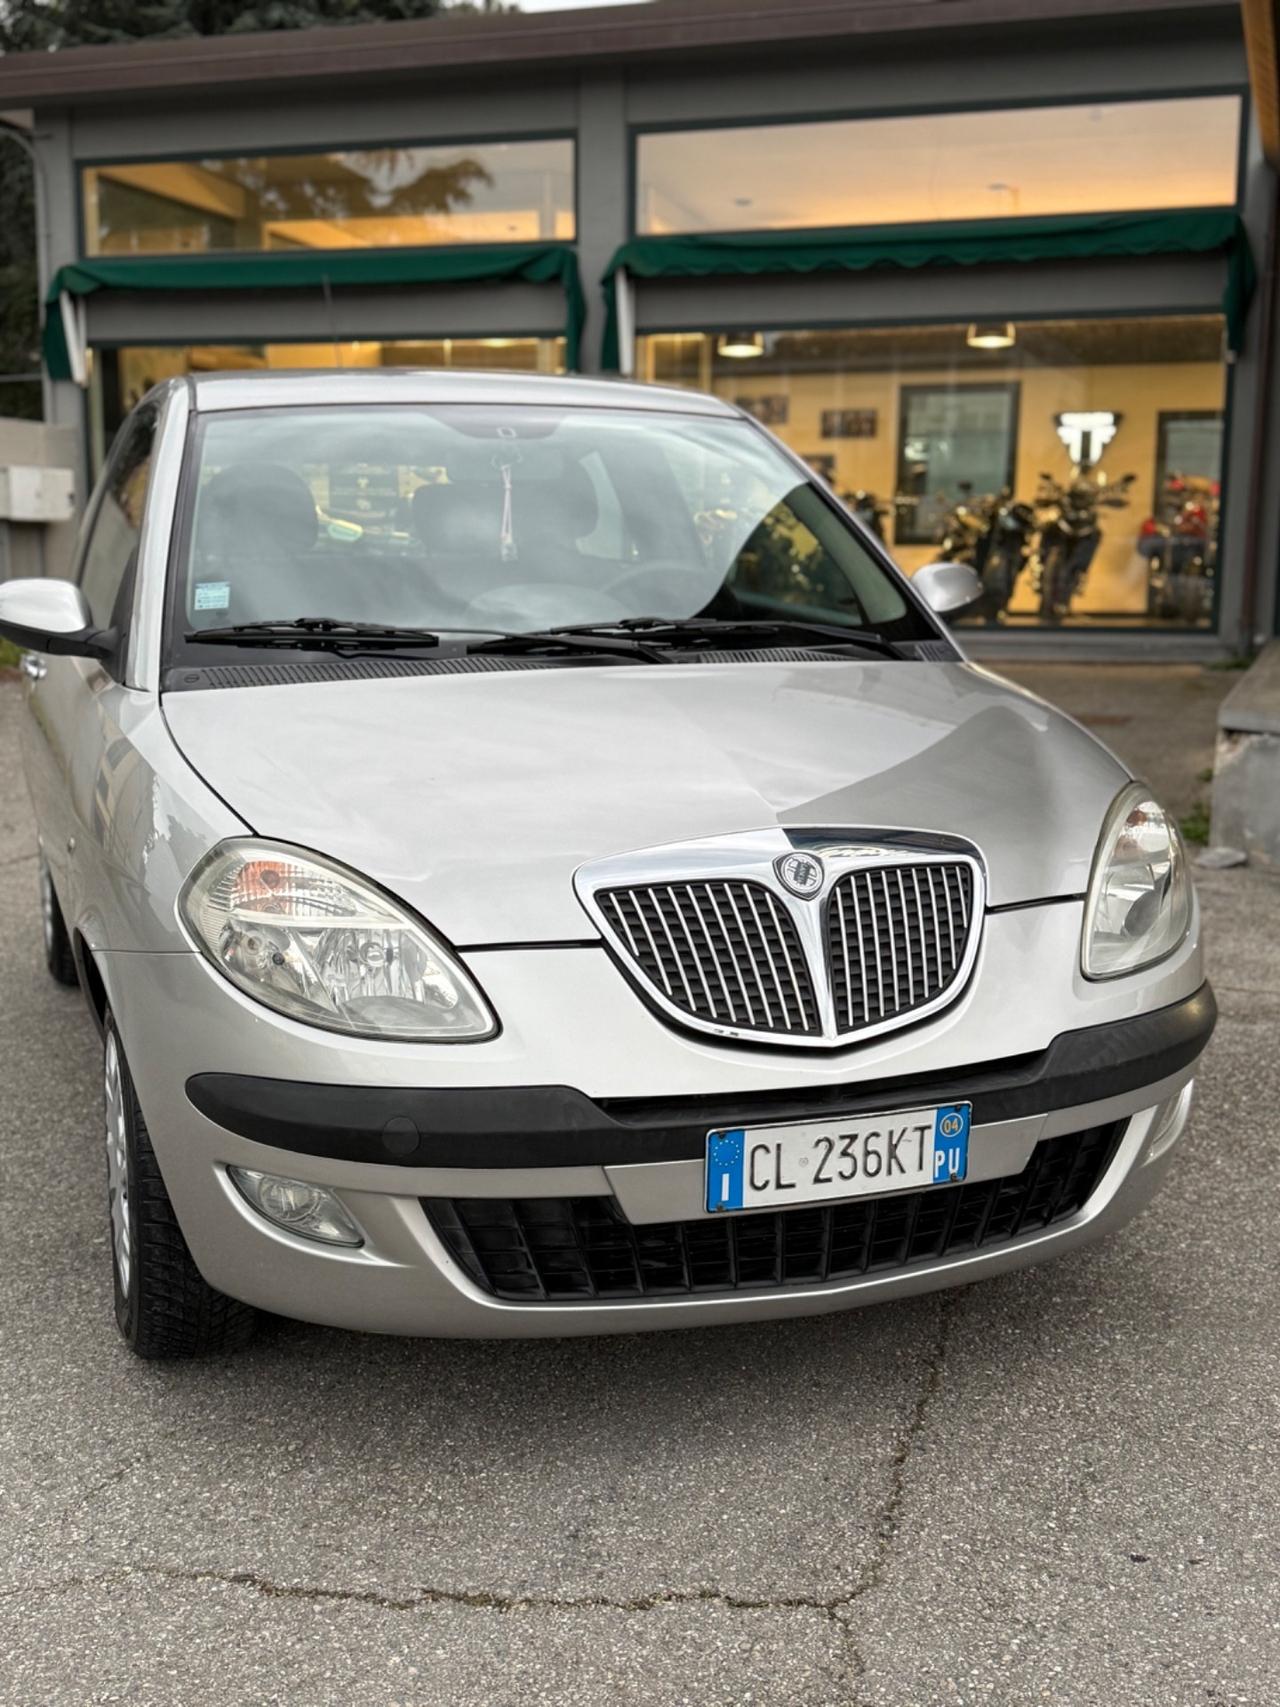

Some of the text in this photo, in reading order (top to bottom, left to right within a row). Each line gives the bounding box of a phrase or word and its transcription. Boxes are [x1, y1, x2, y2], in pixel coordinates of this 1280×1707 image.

[943, 1118, 959, 1133] 04
[749, 1124, 932, 1191] CL 236KT
[934, 1147, 960, 1178] PU
[721, 1173, 730, 1201] I
